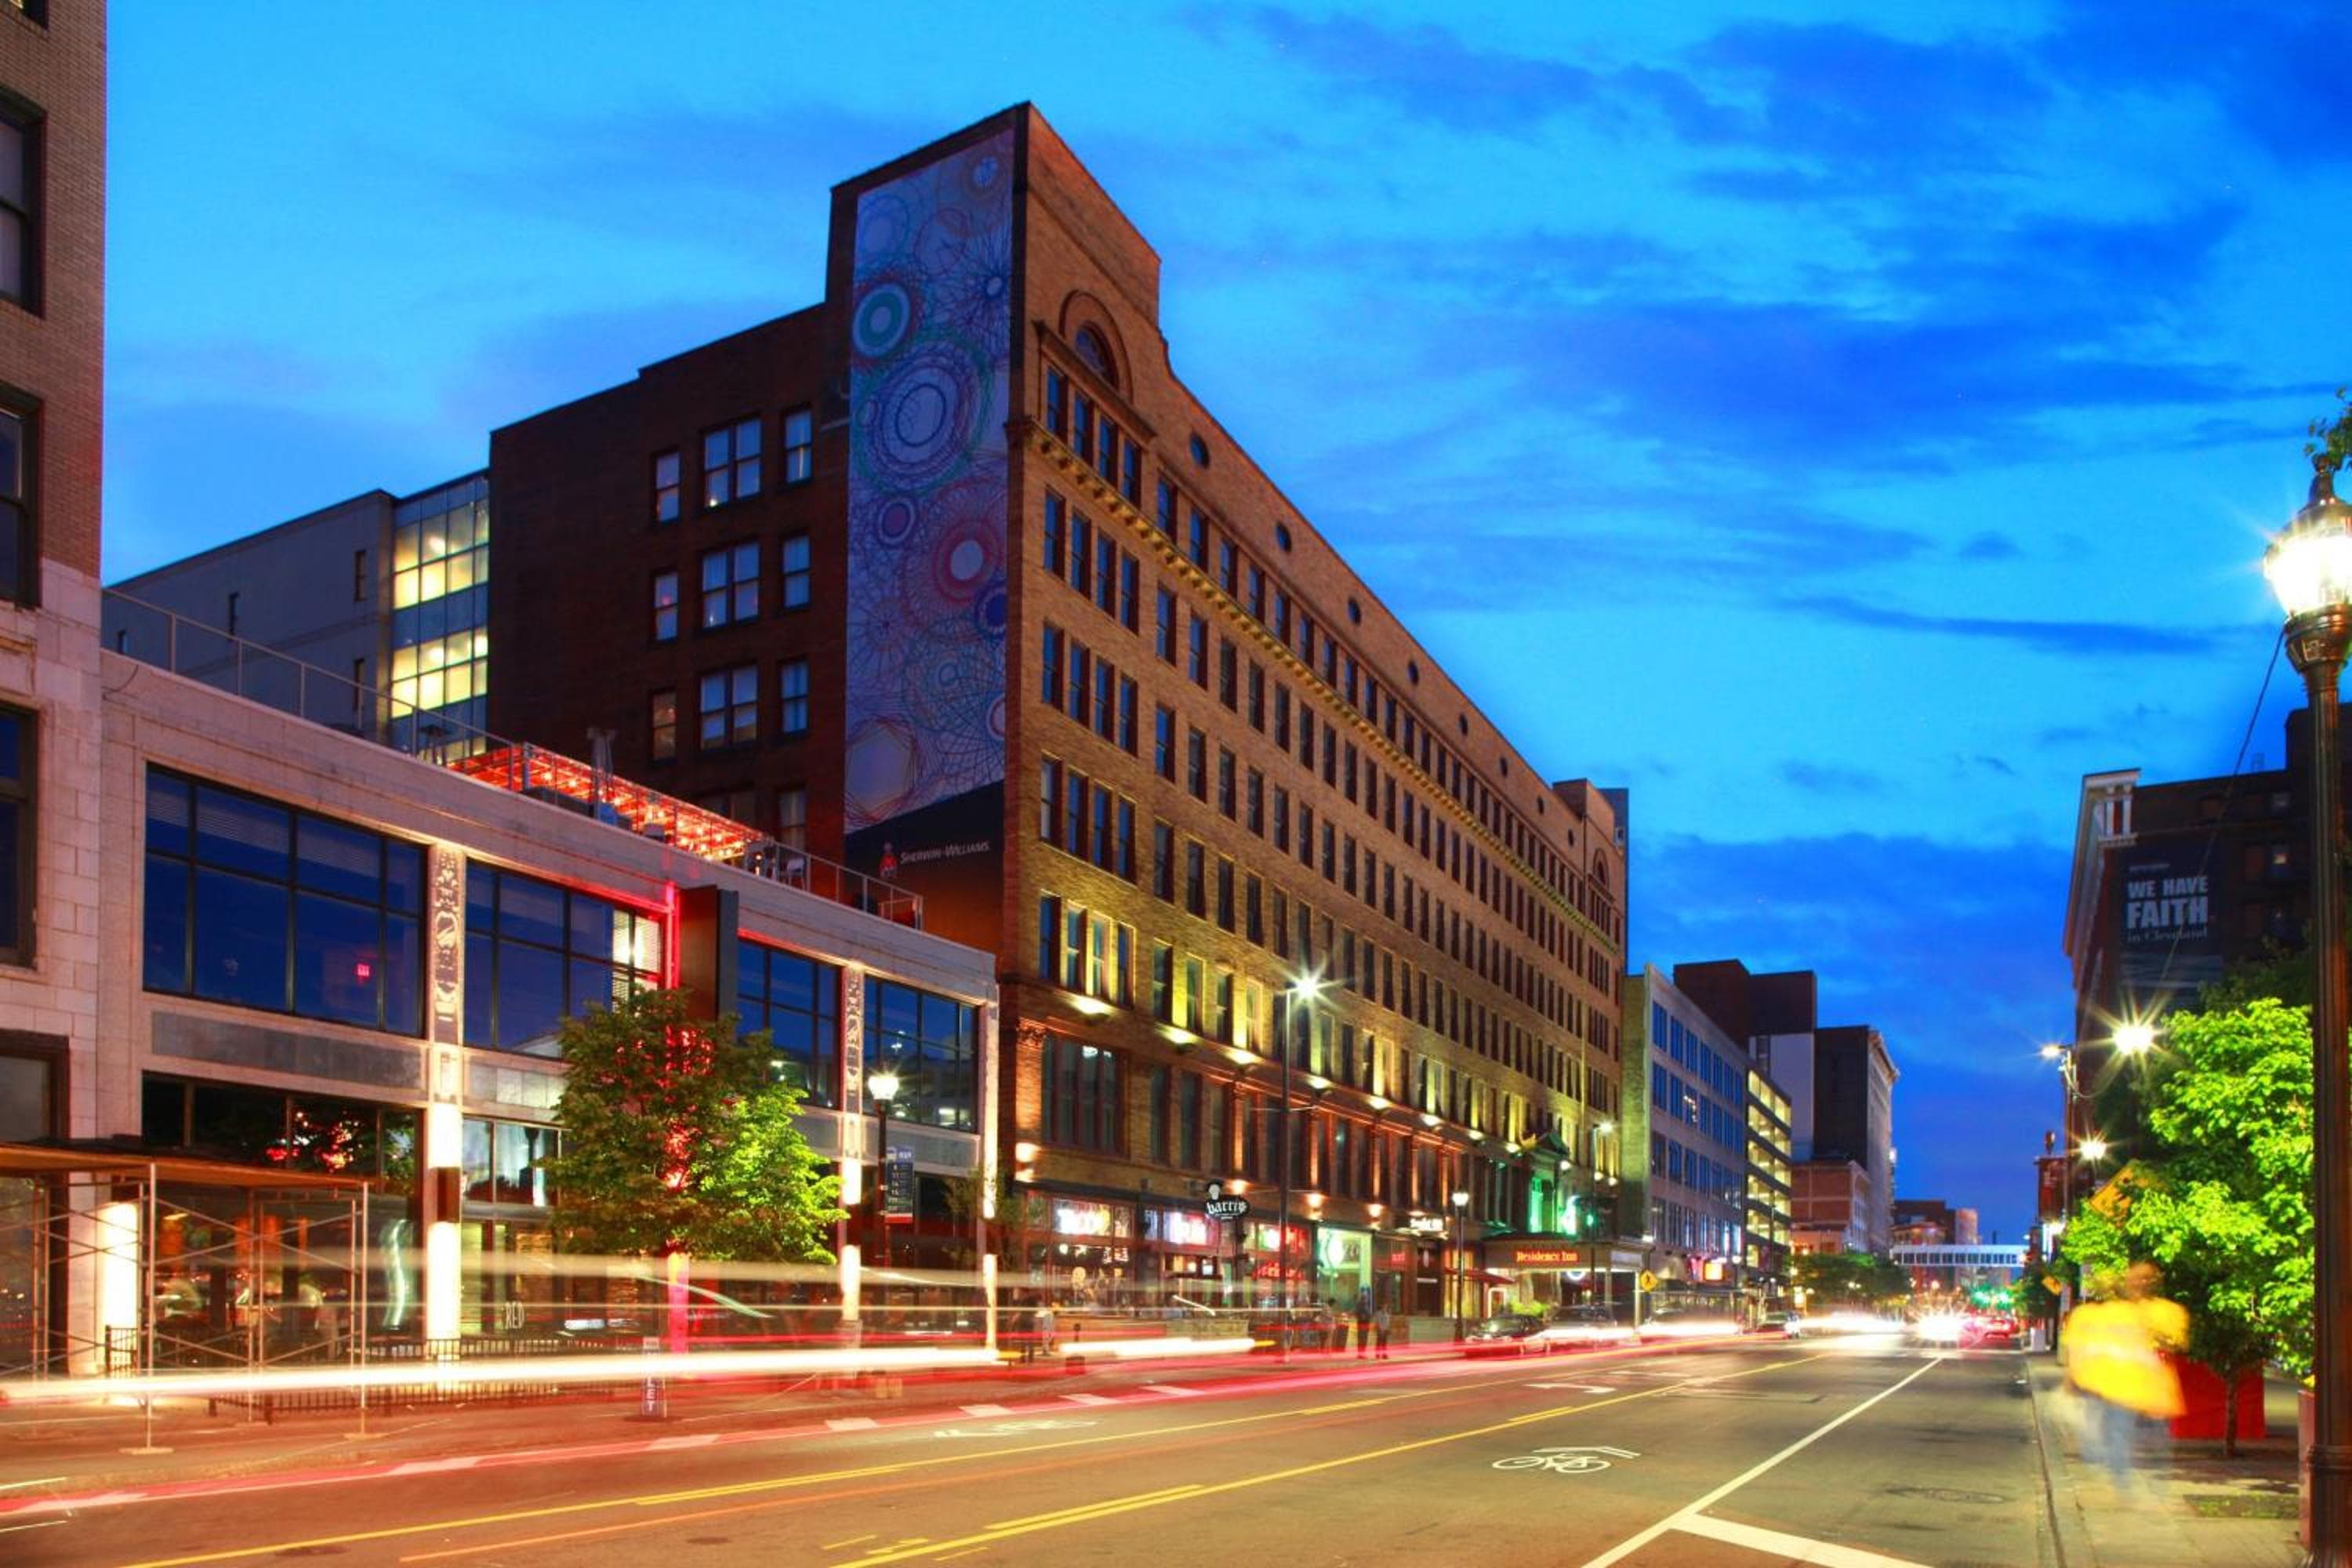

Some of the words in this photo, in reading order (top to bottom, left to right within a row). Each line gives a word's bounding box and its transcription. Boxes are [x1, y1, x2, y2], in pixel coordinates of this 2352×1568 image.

[2128, 880, 2155, 898] WE
[2163, 877, 2208, 895] HAVE
[2127, 896, 2208, 928] FAITH
